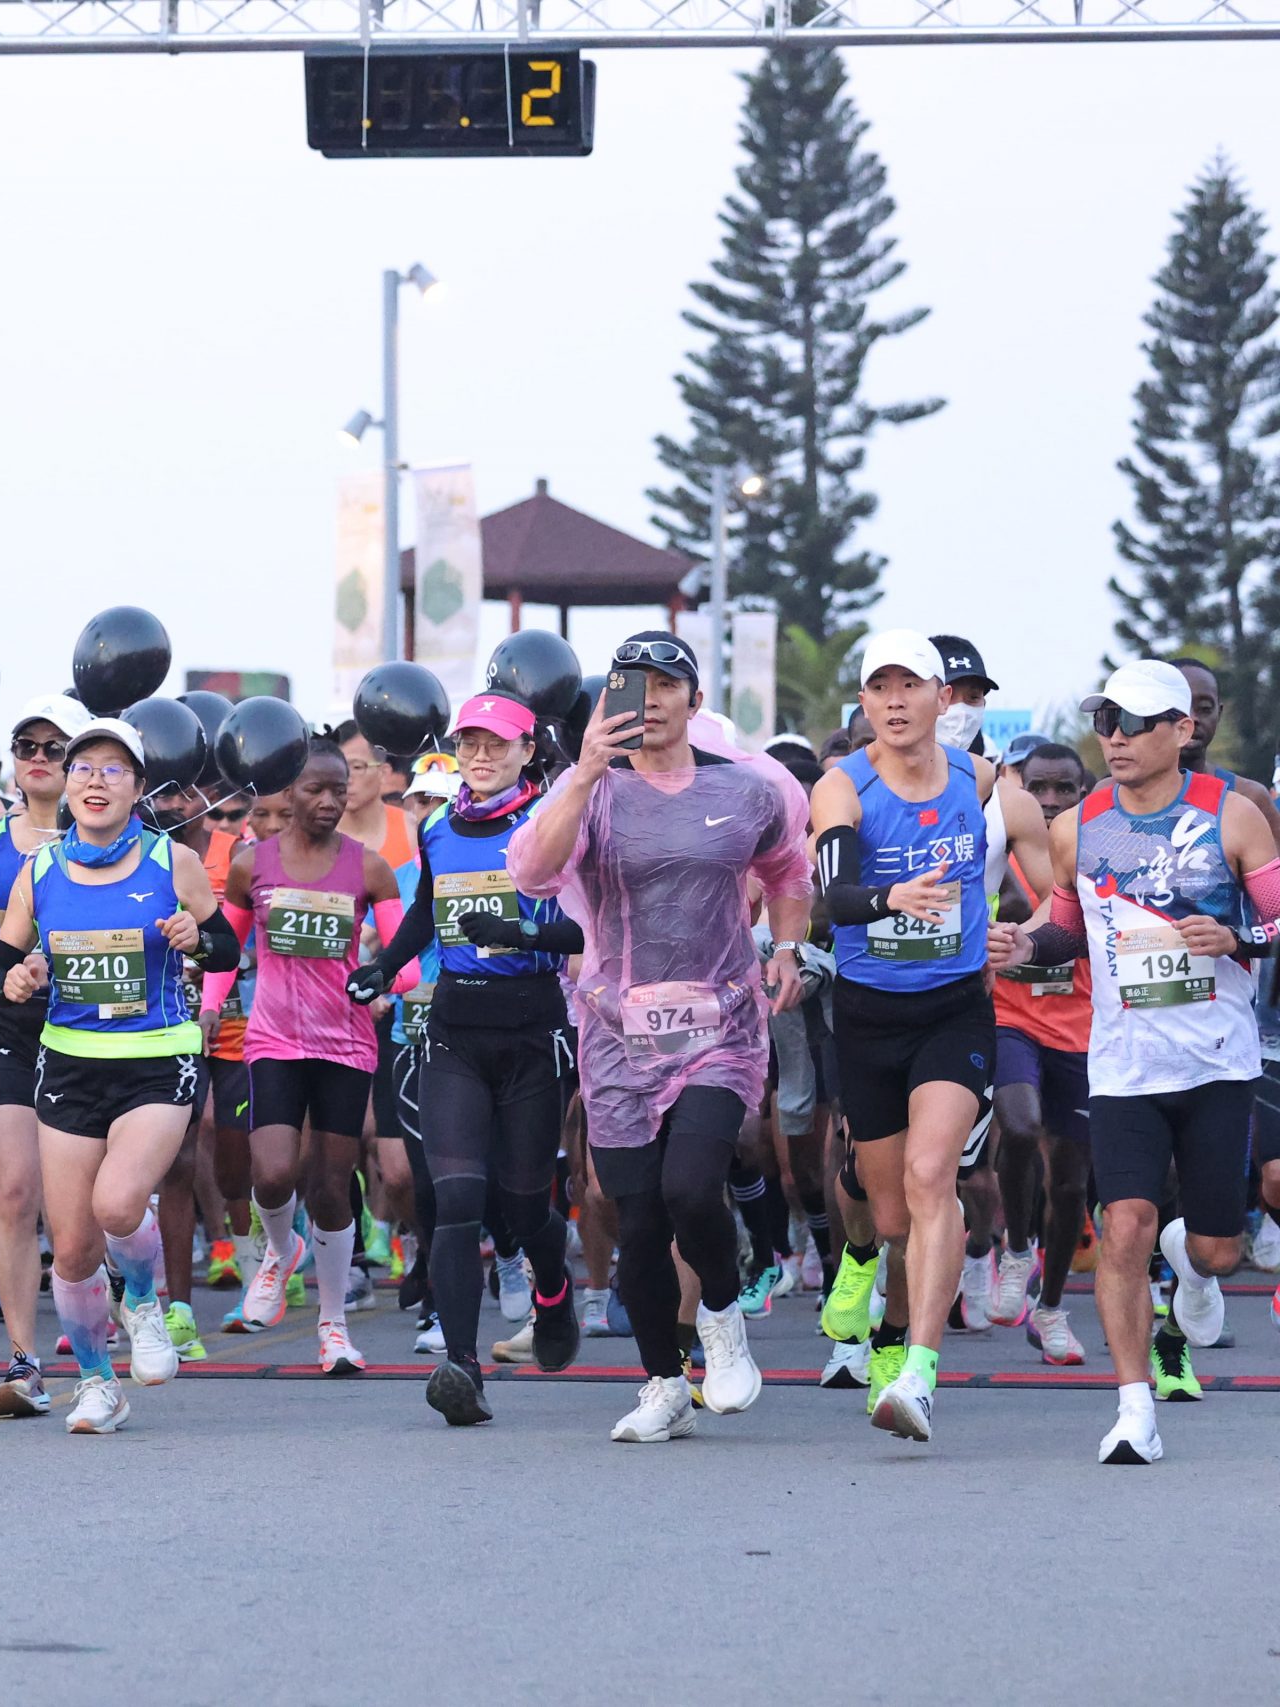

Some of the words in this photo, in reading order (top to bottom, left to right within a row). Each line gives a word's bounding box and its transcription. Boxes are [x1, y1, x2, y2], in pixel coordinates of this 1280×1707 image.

[281, 911, 339, 937] 2113
[111, 933, 124, 941] 42
[271, 936, 296, 945] Monica
[65, 955, 129, 980] 2210
[1142, 952, 1192, 979] 194
[647, 1007, 695, 1032] 974
